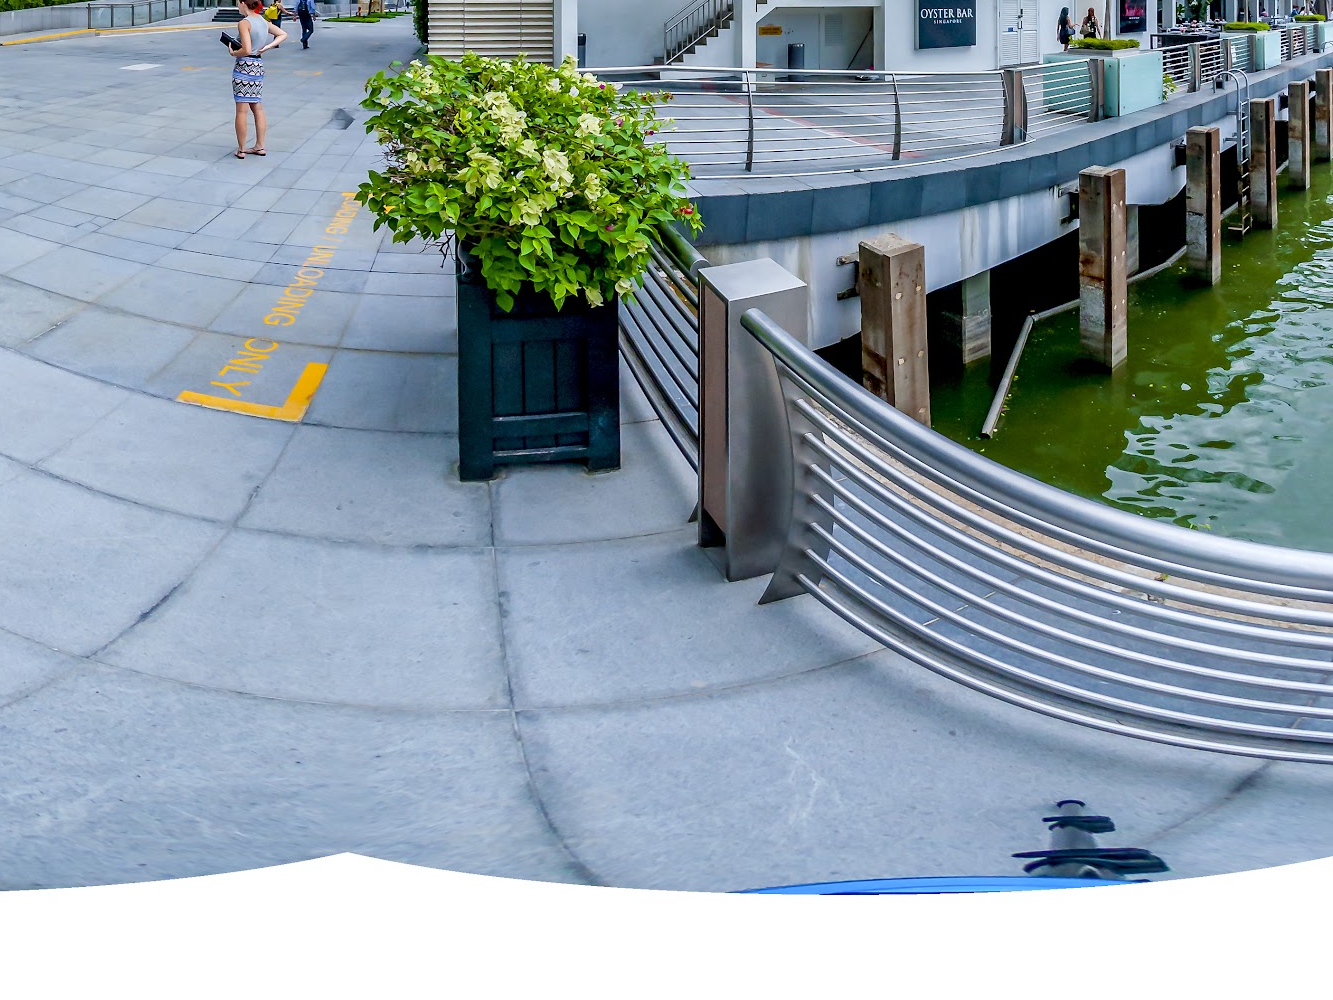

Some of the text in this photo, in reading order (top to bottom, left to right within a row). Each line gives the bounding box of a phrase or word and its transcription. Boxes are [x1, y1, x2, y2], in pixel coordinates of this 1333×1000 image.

[920, 8, 974, 19] OYSTER BAR
[263, 245, 338, 327] UNLOADING
[210, 337, 278, 397] ONLY
